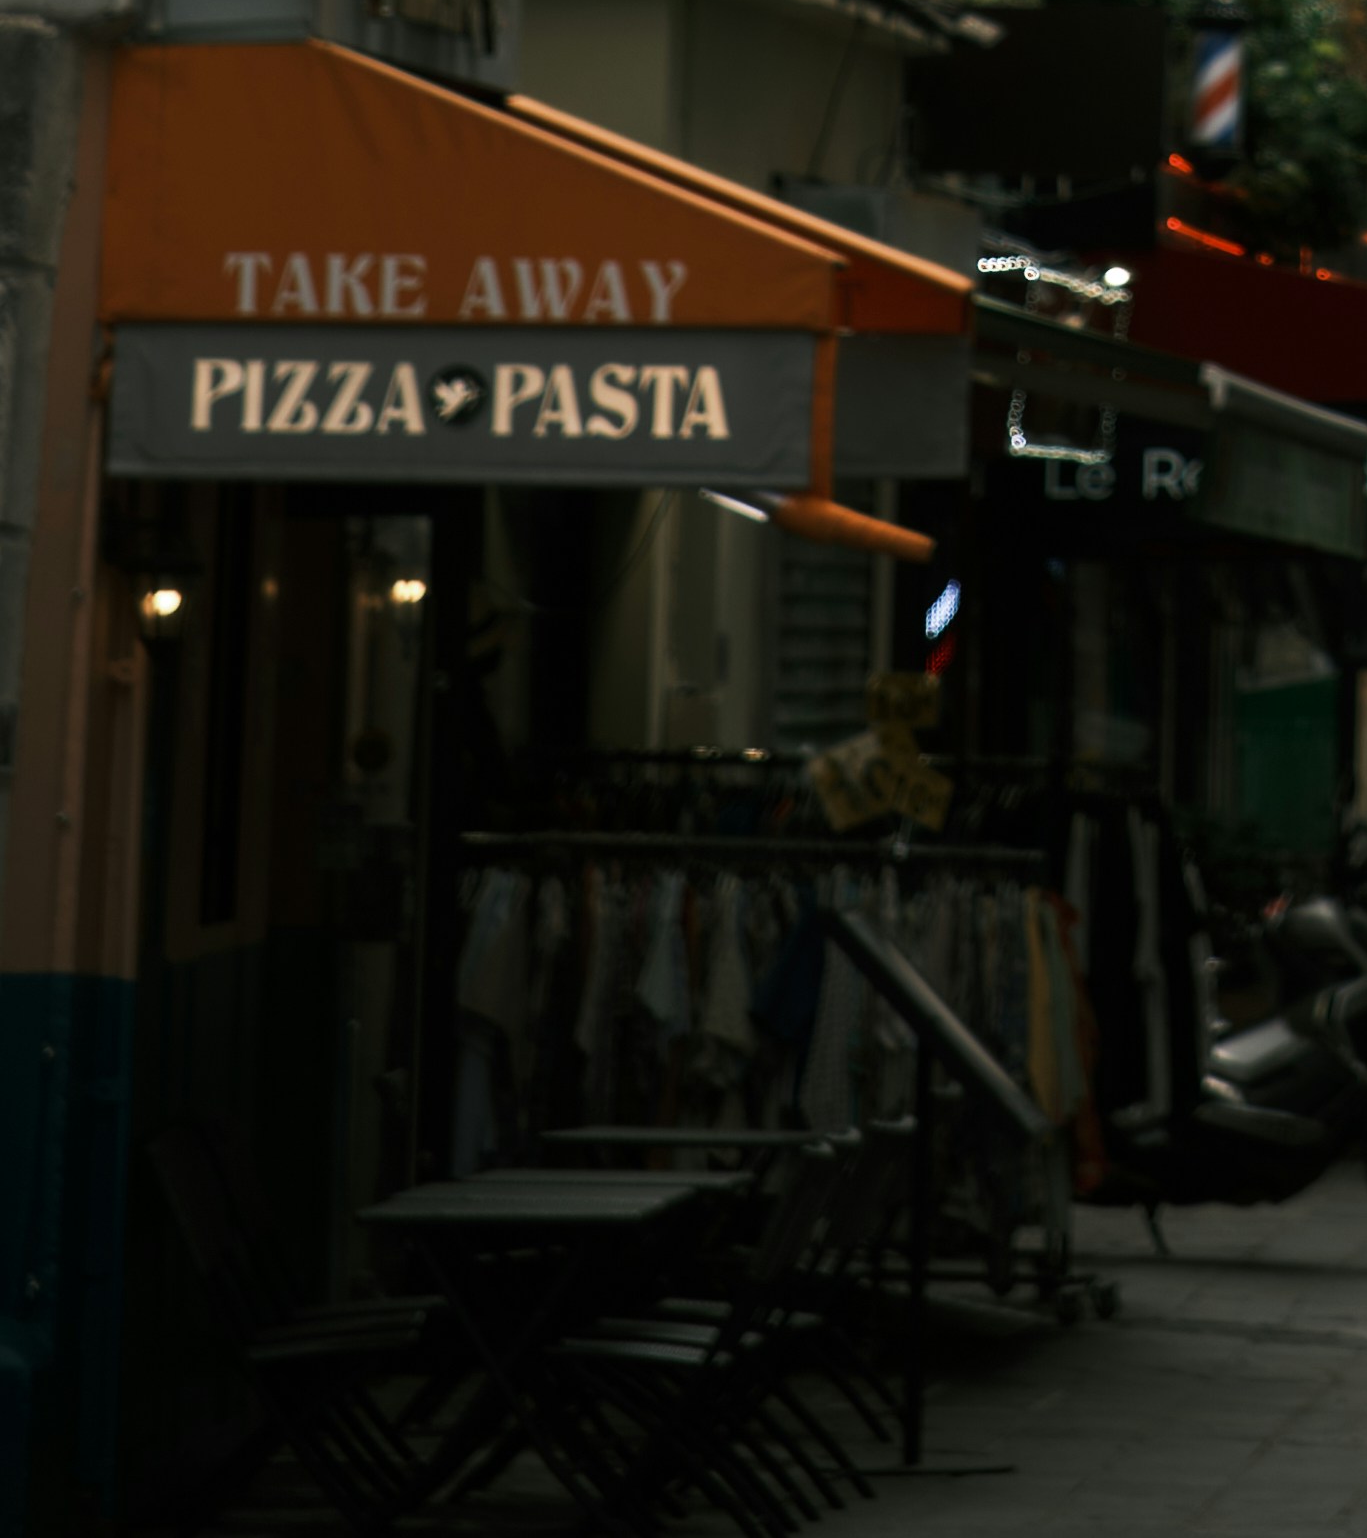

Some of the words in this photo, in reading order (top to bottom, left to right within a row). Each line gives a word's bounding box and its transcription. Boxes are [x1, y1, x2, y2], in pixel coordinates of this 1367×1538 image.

[222, 249, 430, 318] TAKE
[457, 253, 689, 325] AWAY
[189, 357, 427, 435] PIZZA
[489, 362, 732, 441] PASTA
